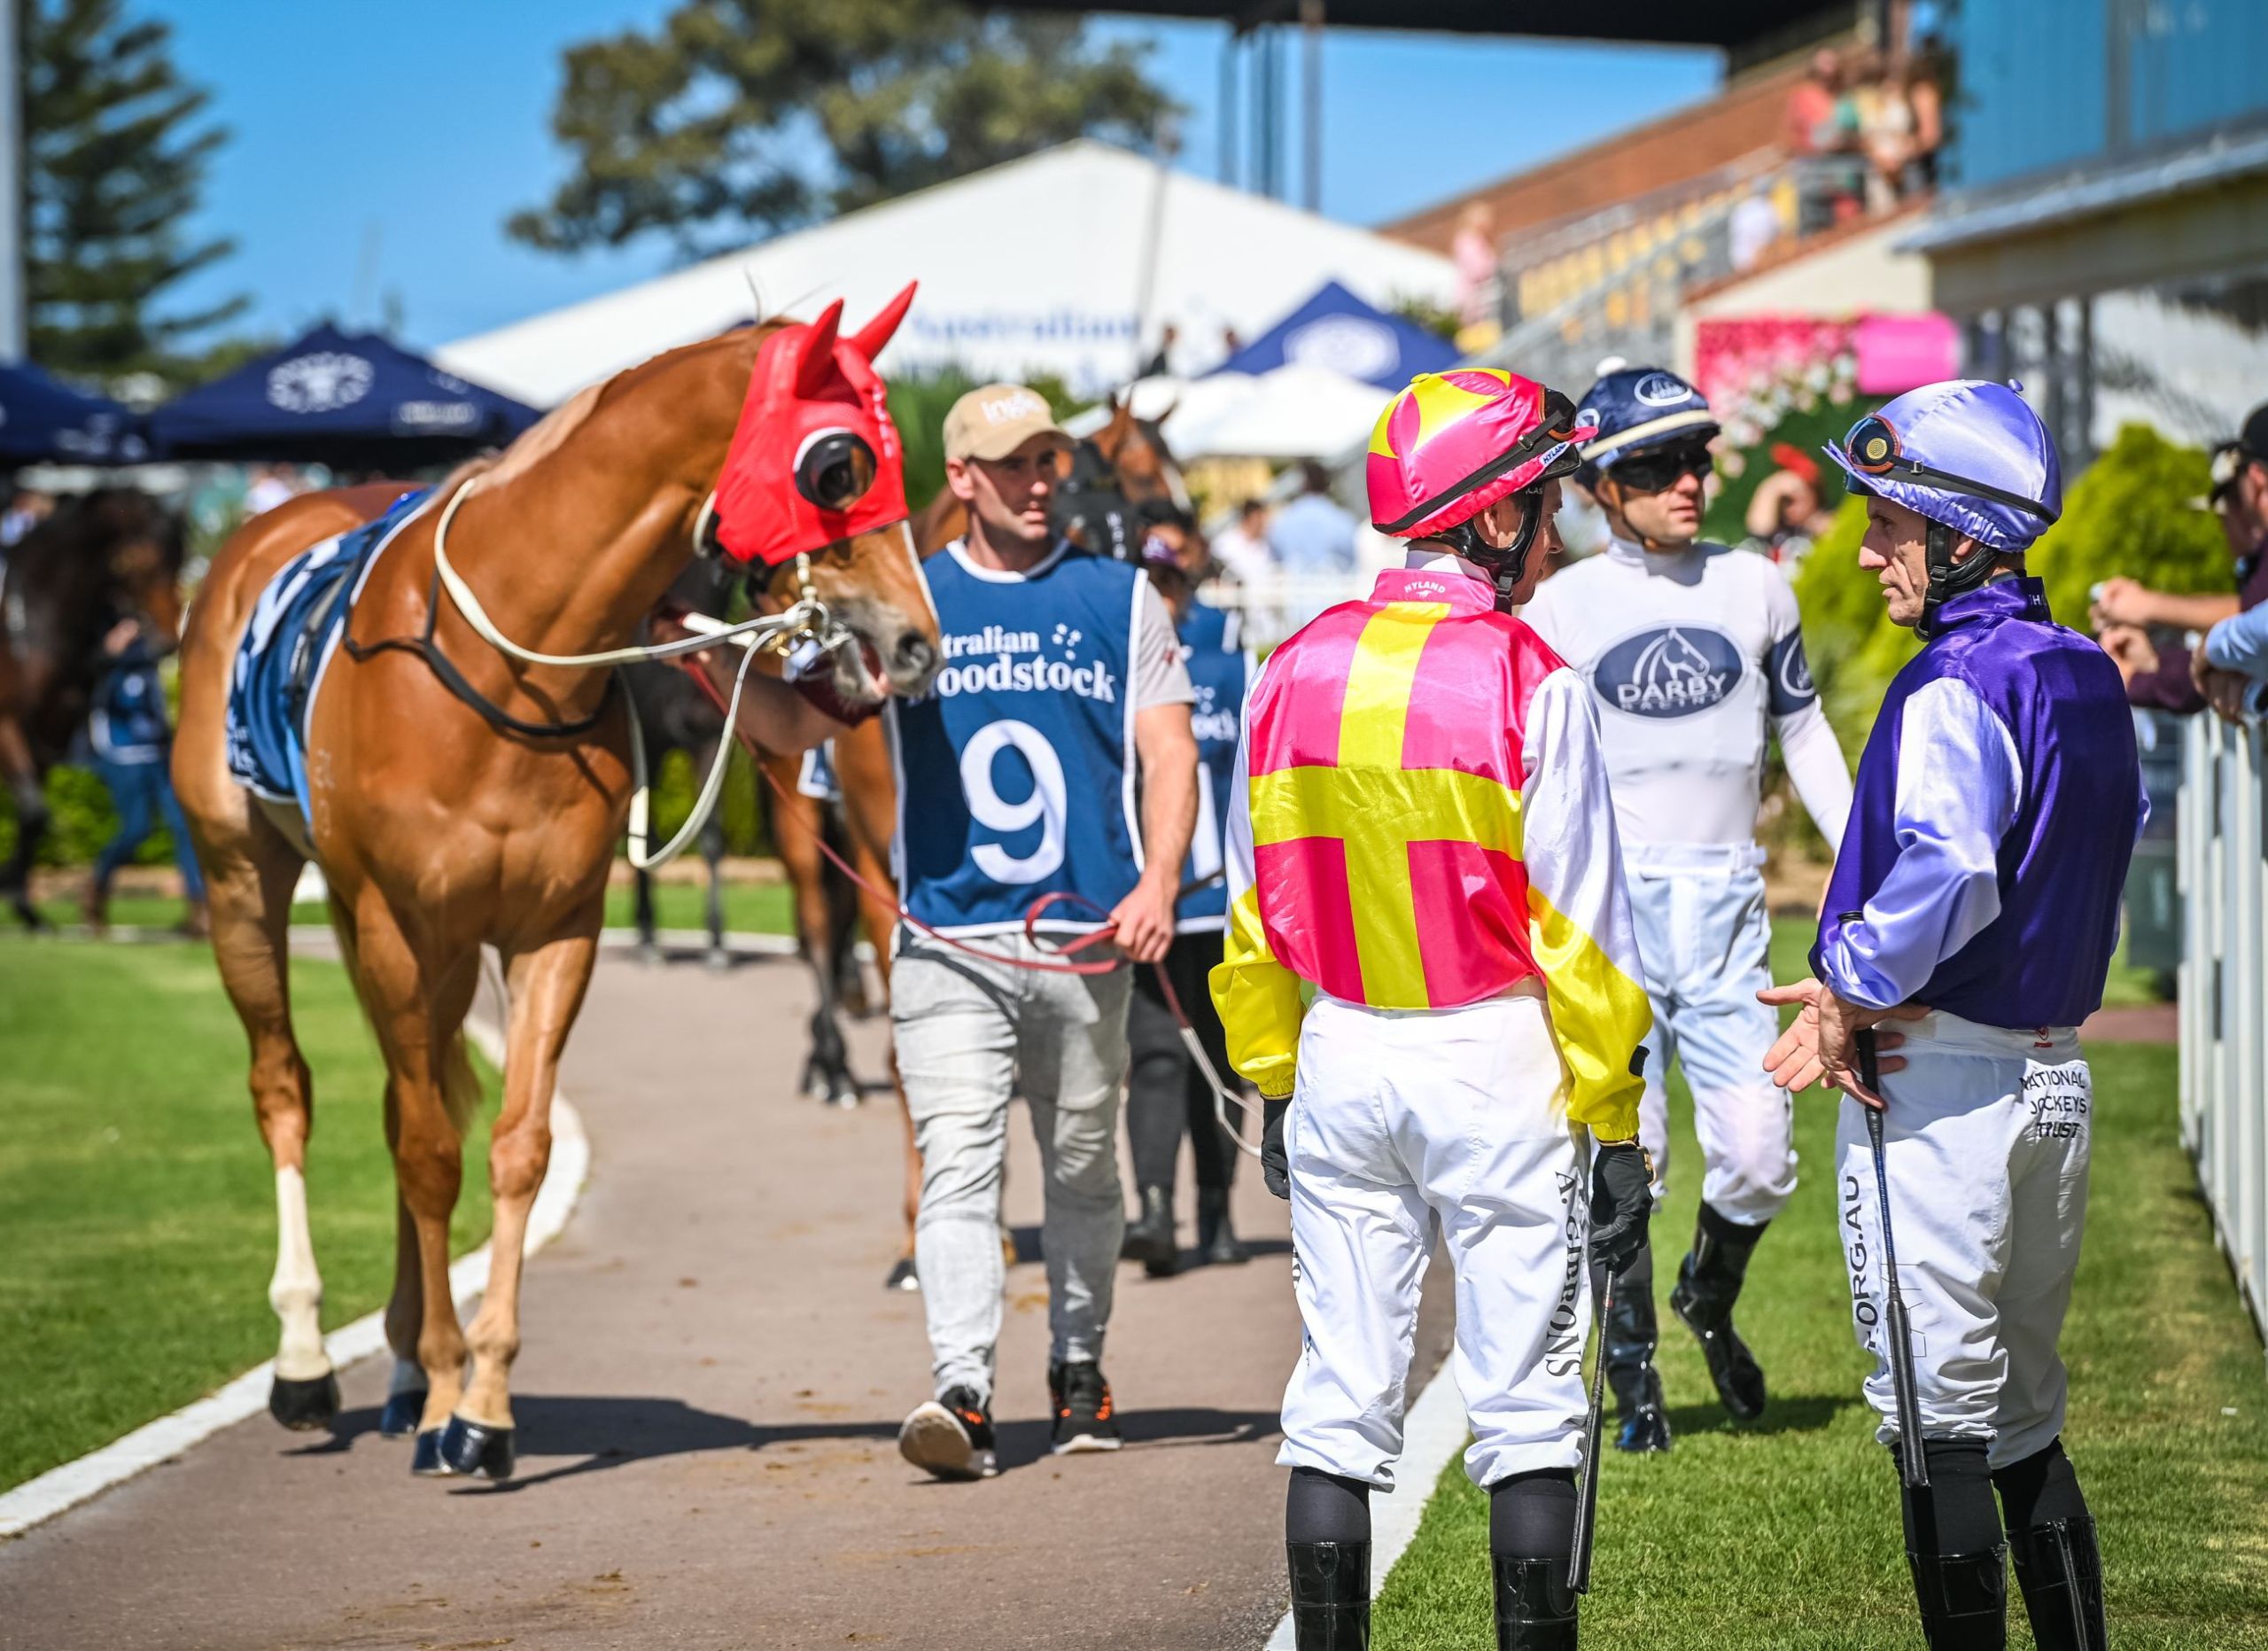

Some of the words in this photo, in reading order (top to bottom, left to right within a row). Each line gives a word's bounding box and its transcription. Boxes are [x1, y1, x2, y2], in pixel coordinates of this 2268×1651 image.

[1403, 580, 1446, 594] HYLAND
[914, 653, 1116, 704] oodstock
[1617, 672, 1727, 704] DARBY
[959, 719, 1068, 884] 9
[2019, 1070, 2086, 1092] NATIONAL
[2030, 1095, 2087, 1115] JOCKEYS
[2036, 1121, 2080, 1139] TRUST
[1555, 1171, 1576, 1204] A.
